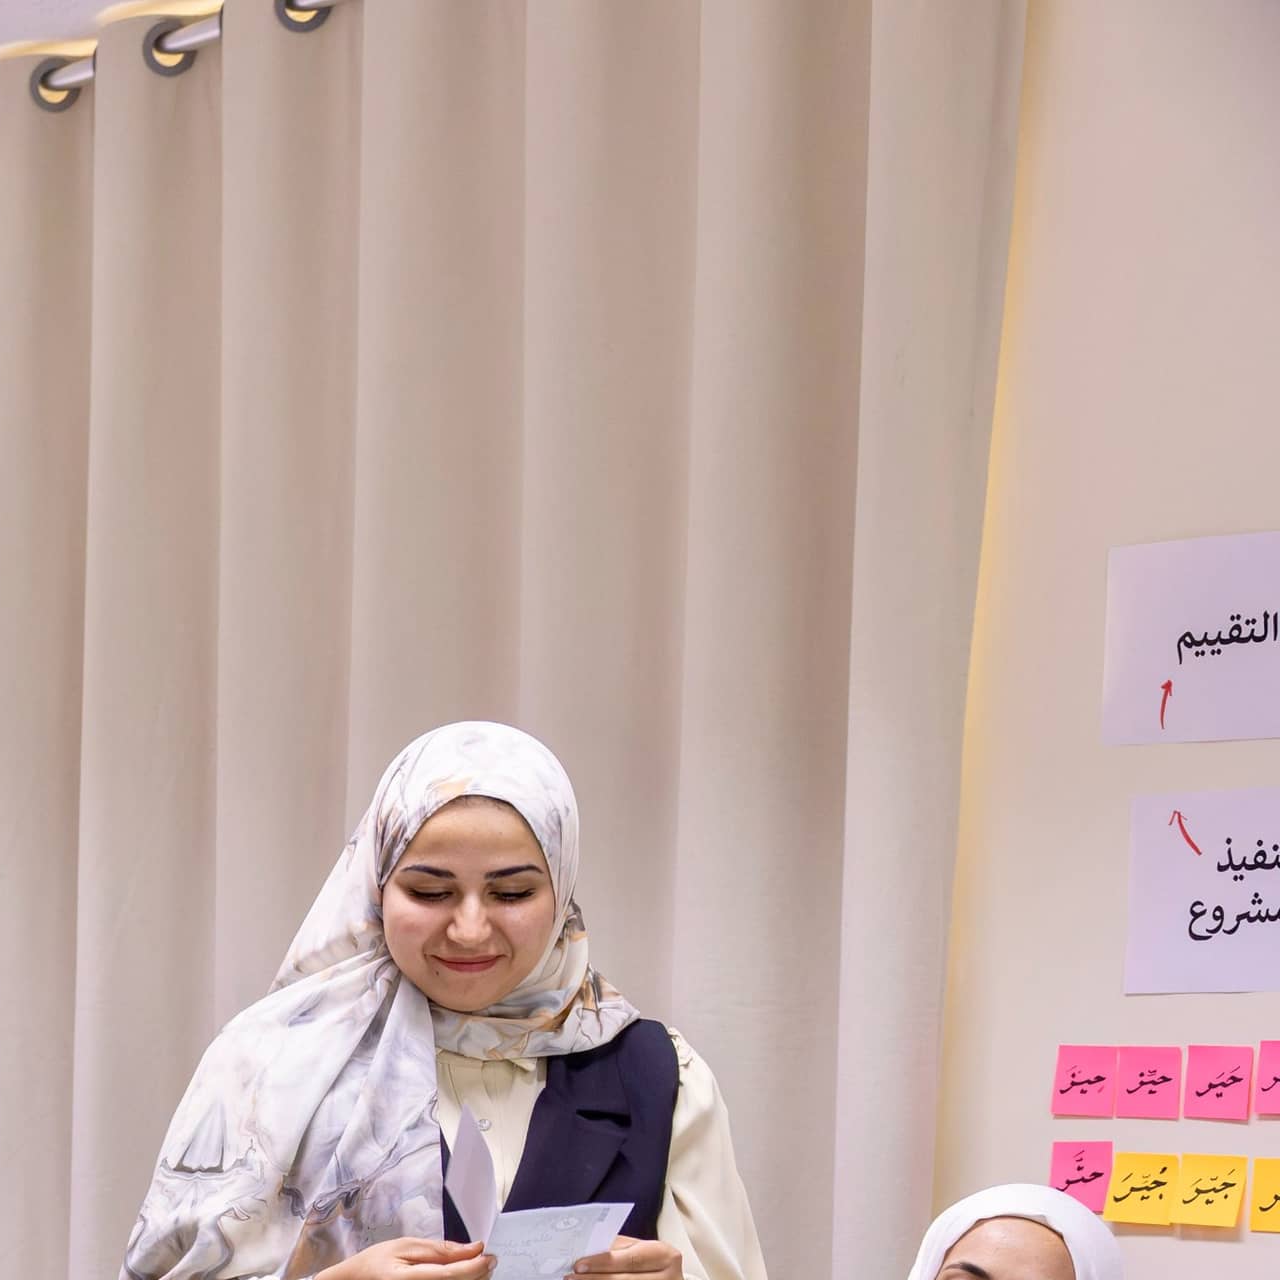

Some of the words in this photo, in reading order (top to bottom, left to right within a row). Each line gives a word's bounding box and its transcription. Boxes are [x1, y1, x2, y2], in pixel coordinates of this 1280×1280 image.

[1176, 609, 1278, 665] التقييم
[1216, 837, 1280, 882] نفيذ
[1188, 892, 1280, 941] شروع
